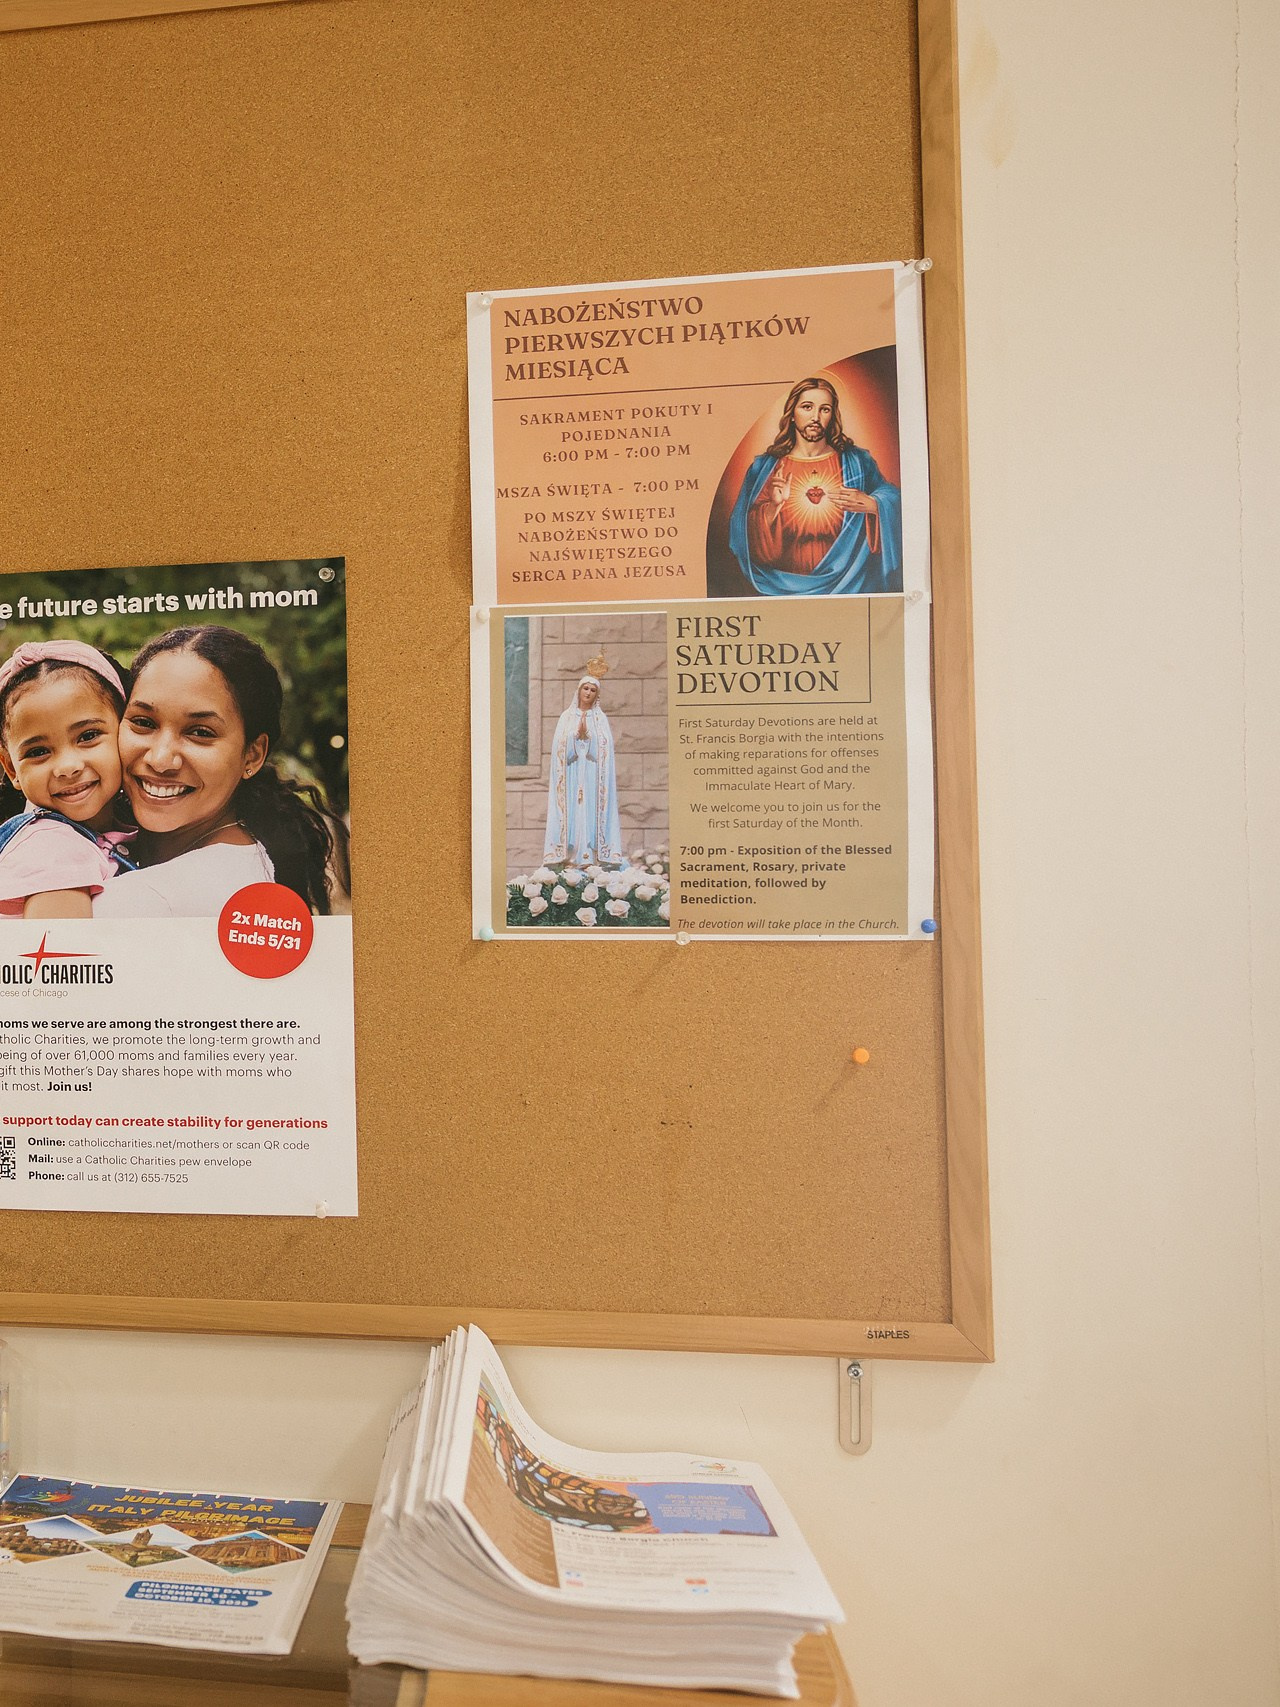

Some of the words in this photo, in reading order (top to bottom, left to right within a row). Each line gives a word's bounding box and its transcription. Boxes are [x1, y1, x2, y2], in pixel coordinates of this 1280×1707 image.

[504, 296, 703, 328] NABOŻEŃSTWO
[504, 326, 675, 355] PIERWSZYCH
[682, 316, 811, 345] PIĄTKÓW
[505, 356, 630, 381] MIESIĄCA
[520, 409, 625, 426] SAKRAMENT
[631, 404, 701, 419] POKUTY
[707, 403, 712, 414] I
[543, 450, 579, 463] 6:00
[584, 448, 609, 461] PM
[625, 446, 660, 458] 7:00
[666, 444, 690, 456] PM
[17, 596, 98, 618] future
[103, 593, 180, 614] starts
[184, 586, 244, 610] with
[250, 589, 318, 608] mom
[676, 615, 762, 638] FIRST
[676, 642, 842, 666] SATURDAY
[677, 670, 839, 694] DEVOTION
[681, 894, 756, 904] Benediction.
[231, 911, 251, 925] 2x
[254, 914, 302, 931] Match
[229, 929, 266, 946] Ends
[268, 934, 301, 950] 5/31
[41, 964, 113, 984] CHARITIES
[21, 988, 31, 997] of
[32, 988, 69, 999] Chicago
[2, 1116, 53, 1127] support
[55, 1115, 93, 1128] today
[95, 1118, 119, 1126] can
[122, 1117, 165, 1127] create
[167, 1116, 222, 1130] stability
[224, 1116, 244, 1128] for
[246, 1117, 328, 1130] generations
[28, 1137, 66, 1147] Online:
[68, 1137, 220, 1150] catholiccharities.net/mothers
[264, 1140, 280, 1150] QR
[283, 1140, 310, 1150] code
[867, 1330, 910, 1339] STAPLES
[114, 1495, 205, 1507] JUBILEE
[213, 1501, 274, 1512] YEAR
[87, 1504, 154, 1516] ITALY
[160, 1509, 296, 1526] PILGRIMAGE
